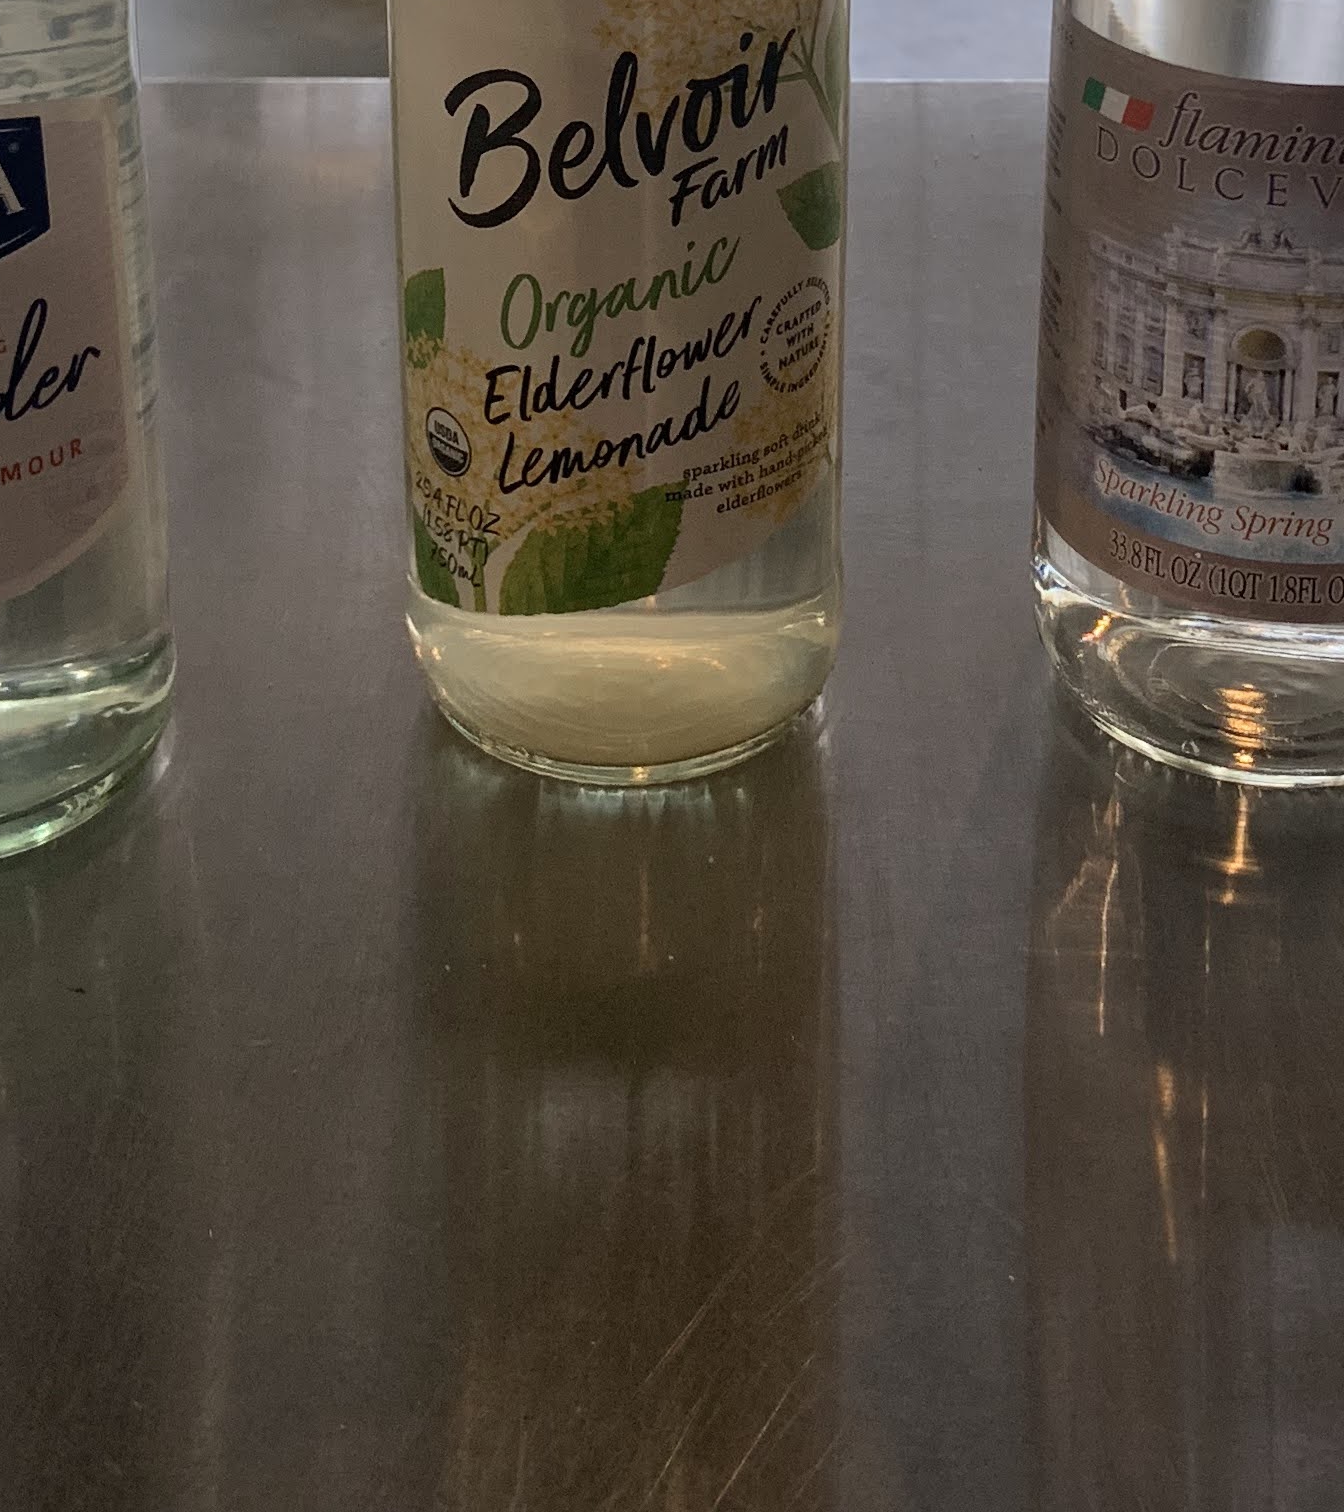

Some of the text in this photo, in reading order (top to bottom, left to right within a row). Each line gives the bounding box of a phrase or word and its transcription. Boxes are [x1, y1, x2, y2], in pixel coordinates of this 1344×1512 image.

[444, 28, 795, 228] Belvoir
[669, 125, 789, 227] Farm
[500, 236, 740, 357] Organic
[776, 300, 822, 336] CRAFTED
[484, 295, 761, 425] Elderflower
[786, 322, 814, 347] WITH
[499, 376, 741, 494] Lemonade
[682, 448, 761, 482] sparkling
[762, 433, 789, 457] soft
[665, 481, 714, 503] made
[717, 470, 756, 493] with
[716, 467, 803, 514] elderflowers
[1095, 458, 1225, 535] Sparkling
[1230, 504, 1335, 546] Spring
[469, 504, 501, 537] OZ
[1171, 554, 1202, 590] OZ
[1208, 567, 1263, 601] (1QT
[1269, 576, 1323, 605] 1.8FL
